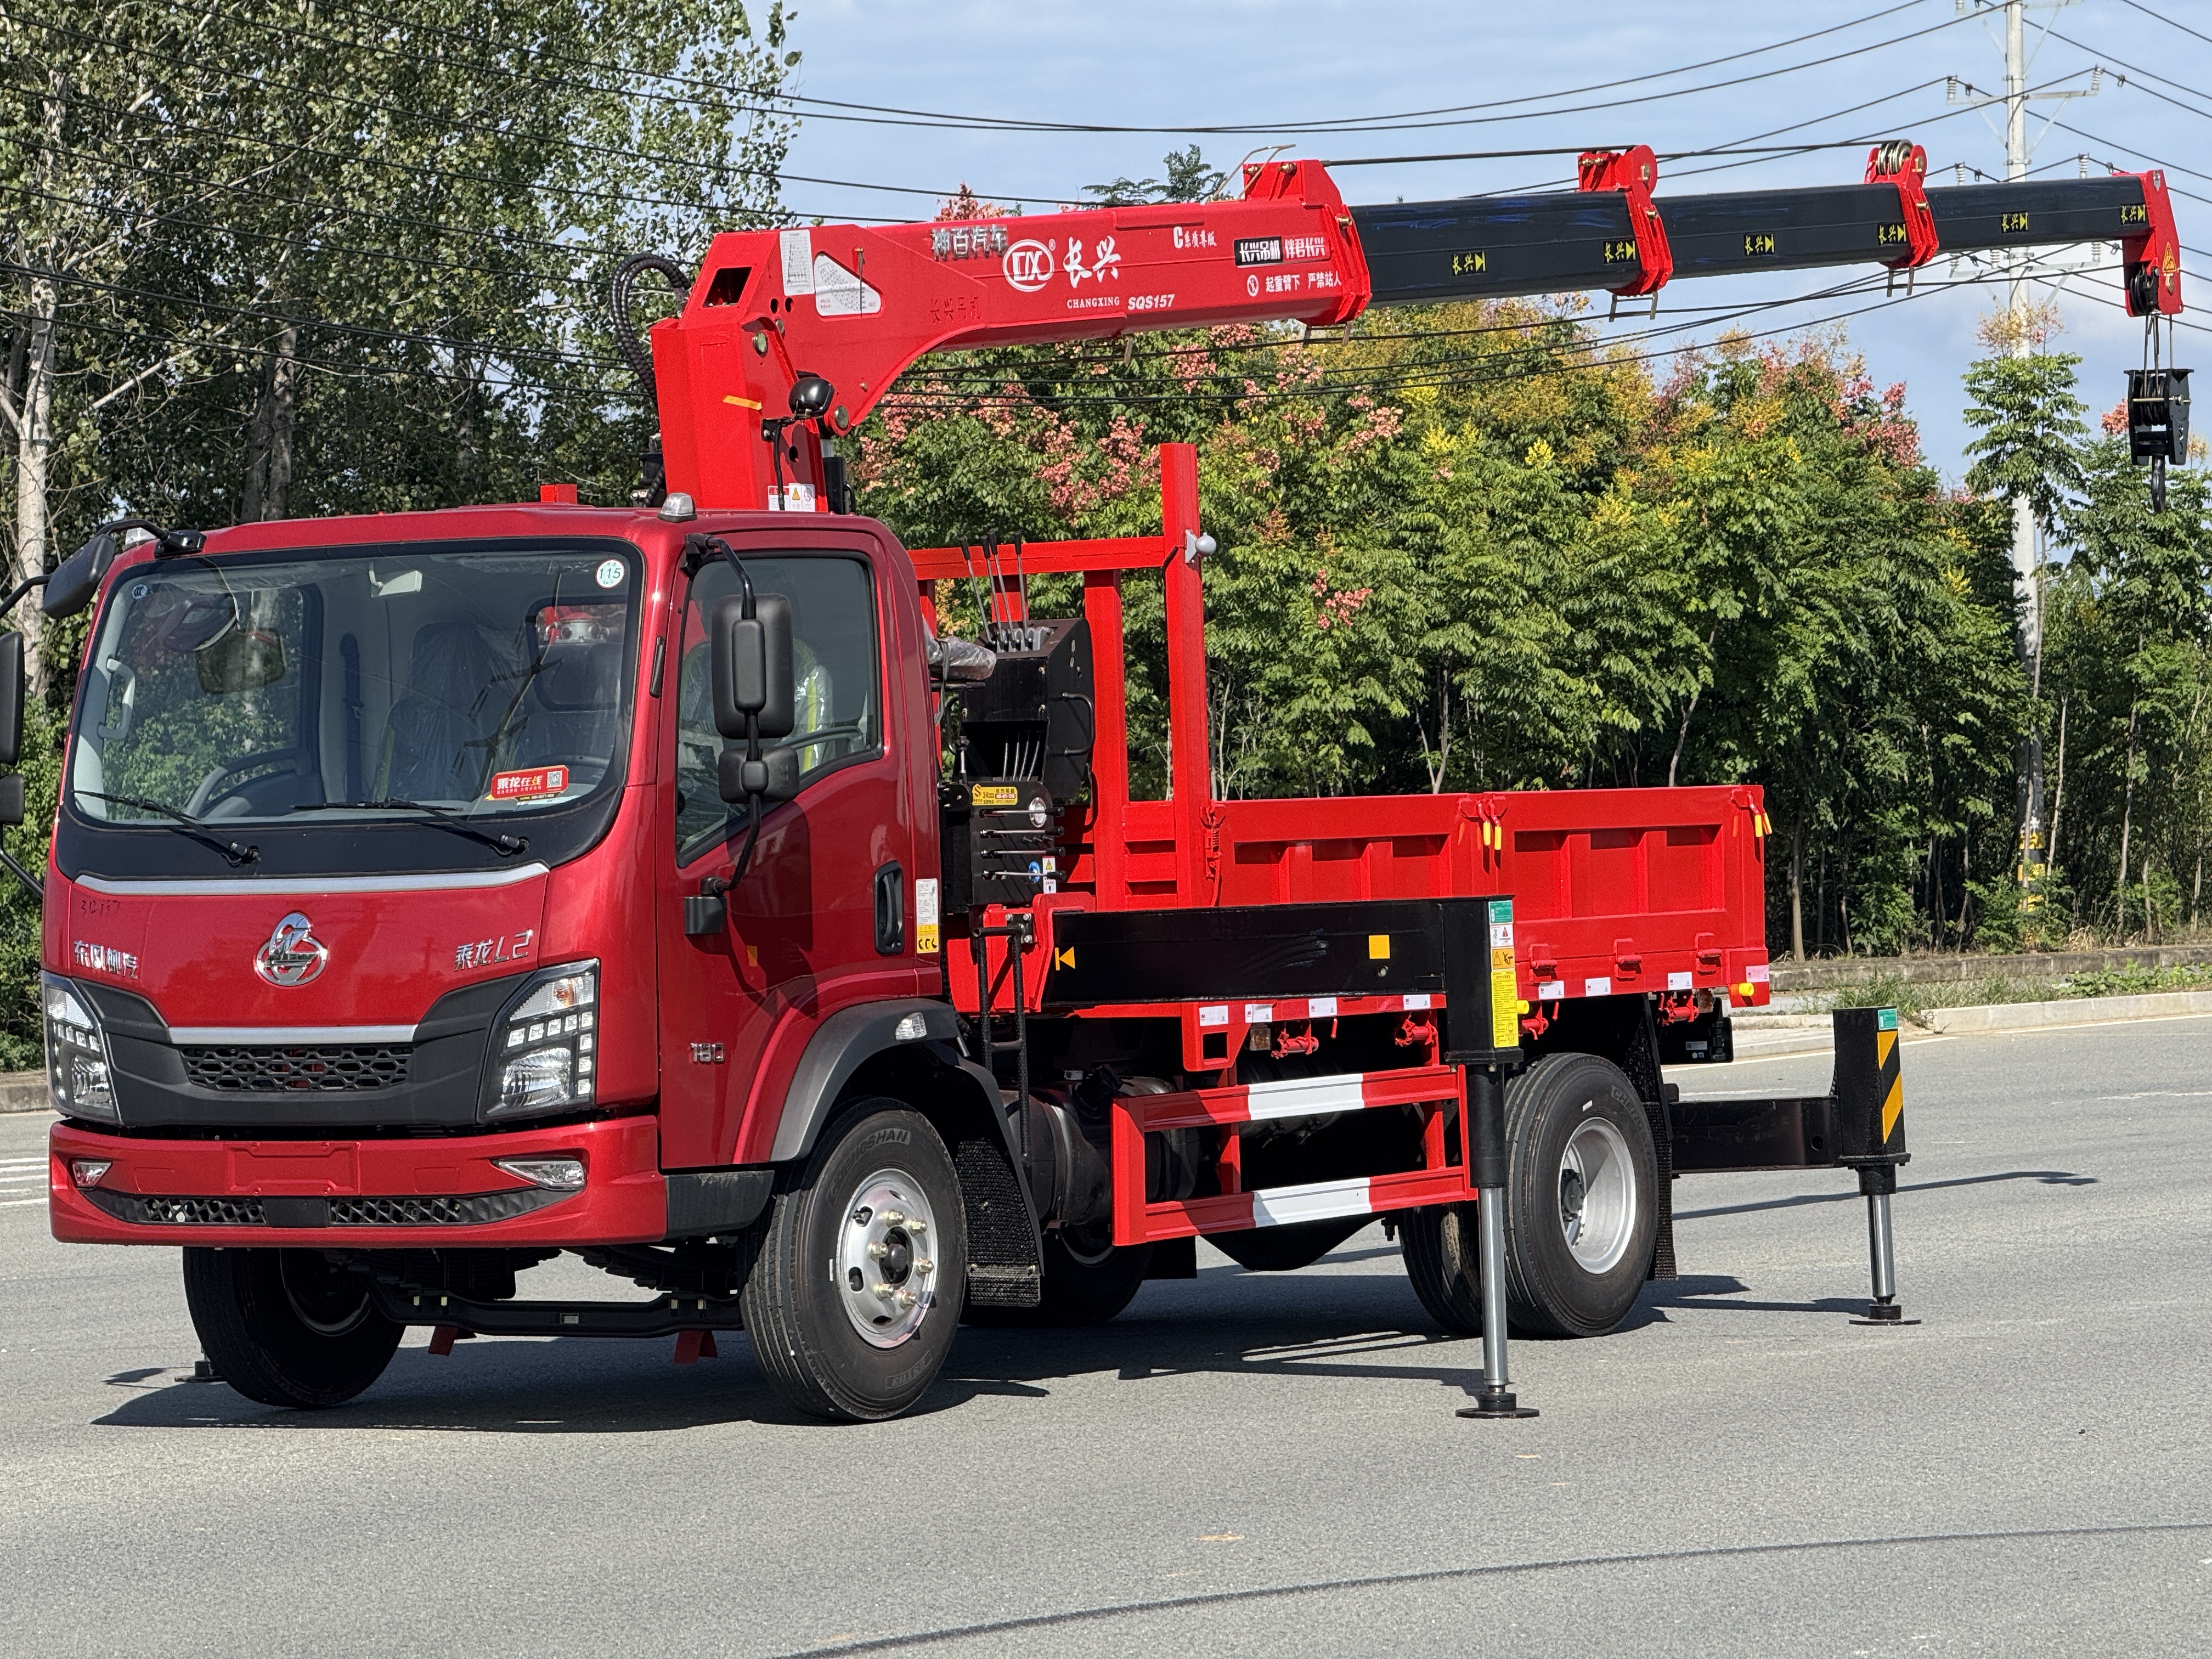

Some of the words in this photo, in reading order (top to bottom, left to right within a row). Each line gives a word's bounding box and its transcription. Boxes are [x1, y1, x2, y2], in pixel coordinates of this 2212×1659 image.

[1879, 224, 1896, 245] 长兴
[1239, 240, 1281, 262] 长兴吊机
[1285, 236, 1325, 258] 伴君长兴
[1605, 241, 1624, 263] 长兴
[1745, 235, 1763, 256] 长兴
[1063, 235, 1121, 289] 长兴
[1452, 252, 1474, 275] 长兴
[1265, 274, 1301, 293] 起重臂下
[1307, 272, 1342, 289] 严禁站人
[1066, 296, 1120, 309] CHANGXING
[1128, 294, 1175, 311] SQS157
[599, 568, 621, 579] 115
[497, 775, 543, 790] 乘龙在线
[690, 1043, 725, 1062] 180
